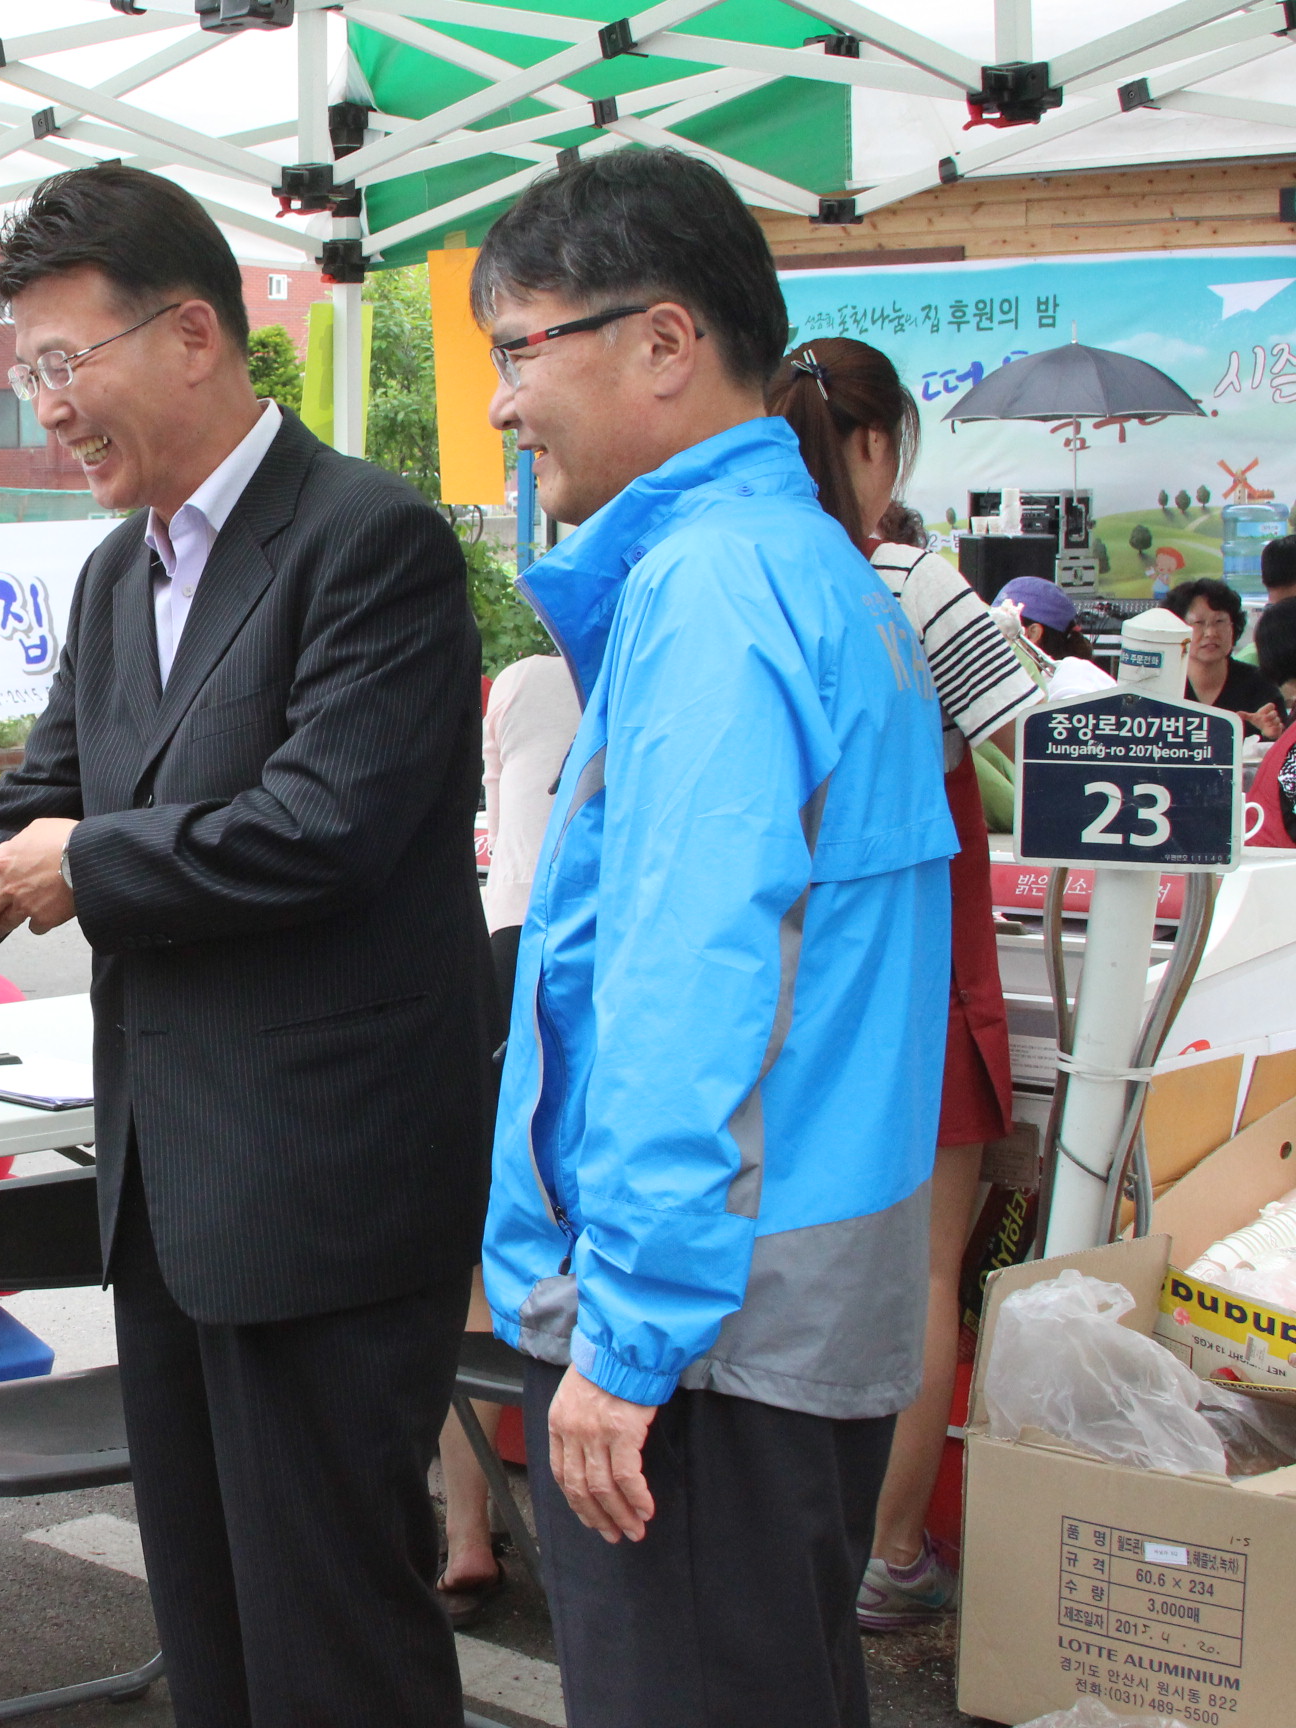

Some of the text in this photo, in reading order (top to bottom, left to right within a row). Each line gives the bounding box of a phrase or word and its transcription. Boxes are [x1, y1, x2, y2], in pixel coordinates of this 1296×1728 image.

[947, 296, 1019, 333] 후원의
[1036, 294, 1060, 329] 밤
[1048, 713, 1208, 743] 중앙로207번길
[1046, 742, 1211, 762] Jungang-ro 207beon-gil
[1080, 781, 1171, 847] 23
[1015, 874, 1048, 896] 밝은
[1215, 1344, 1225, 1355] 13
[1267, 1365, 1286, 1378] NET
[1136, 1568, 1166, 1588] 60.6
[1188, 1579, 1215, 1598] 234
[1063, 1606, 1105, 1631] 제조일자
[1058, 1635, 1241, 1691] LOTTE ALUMINIUM
[1060, 1656, 1238, 1712] 경기도 안산시 원시동 822
[1148, 1699, 1220, 1726] 489-5500
